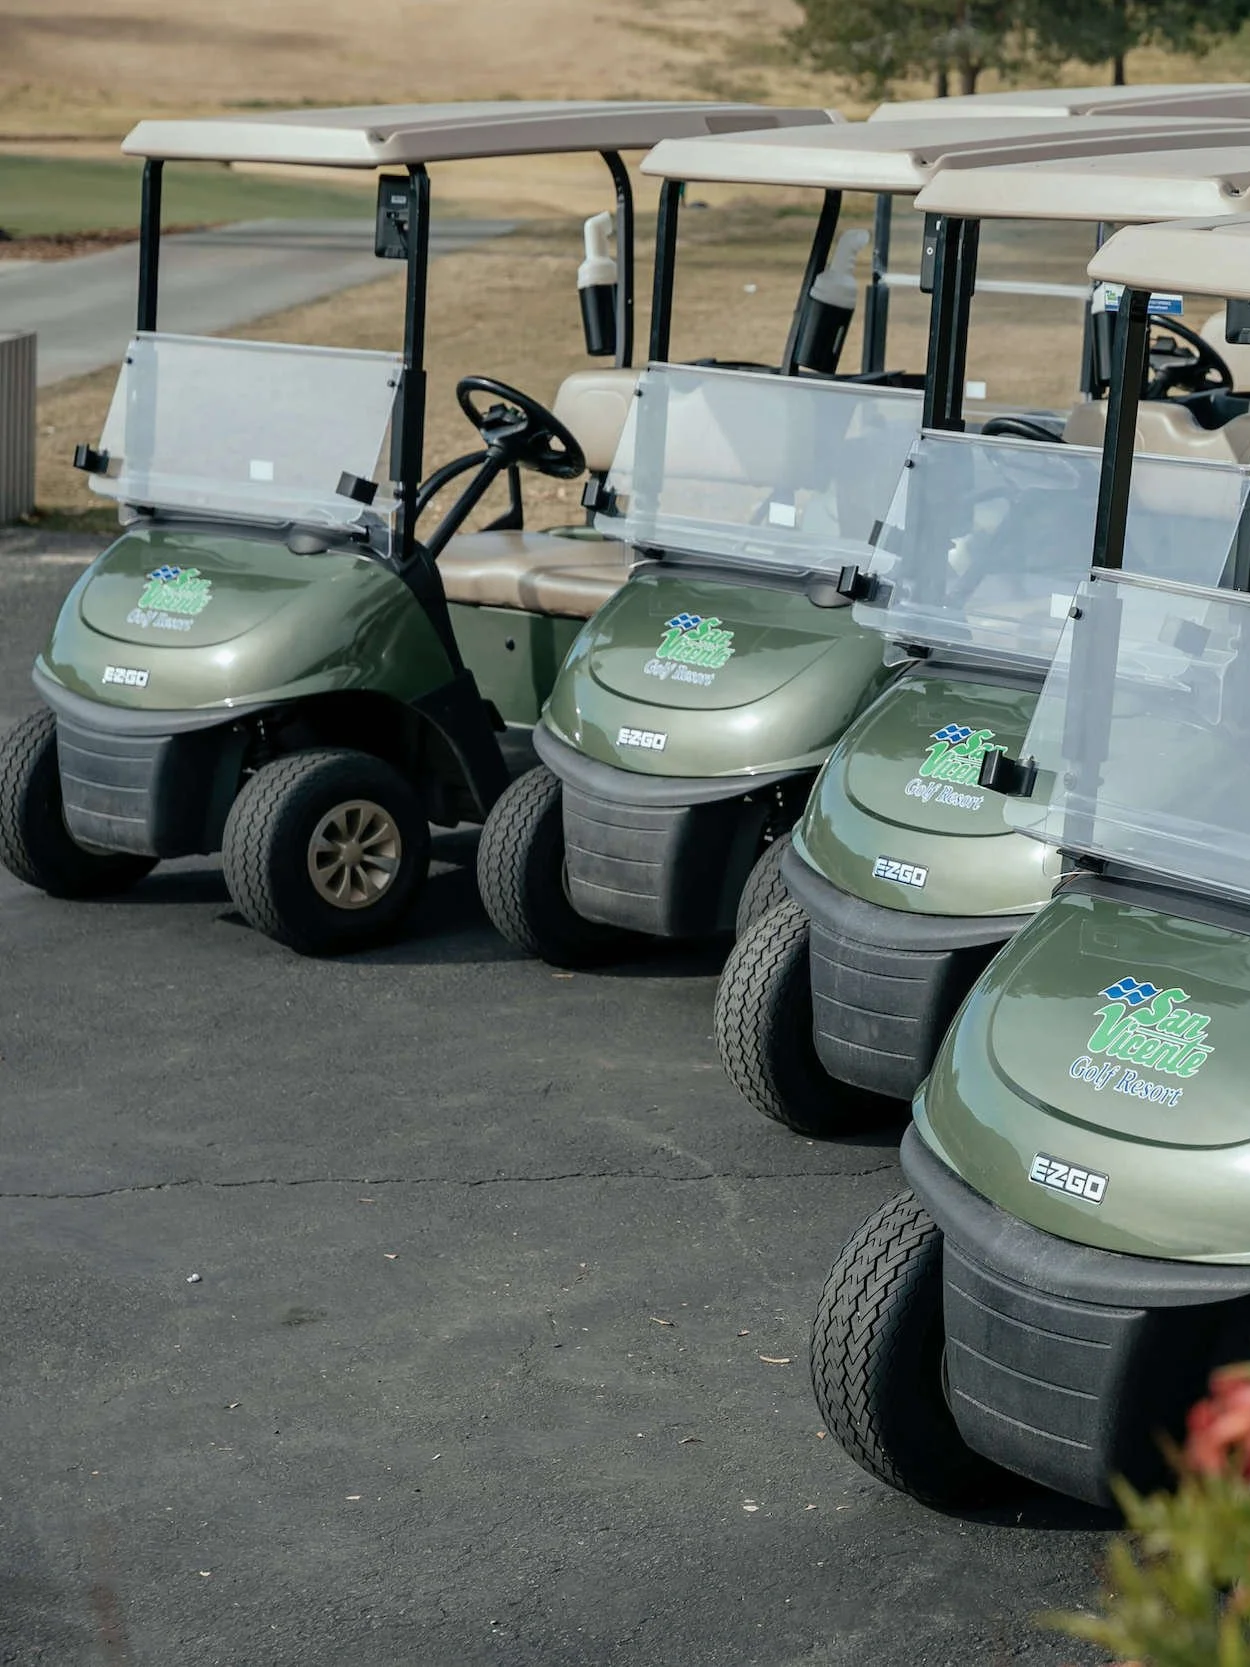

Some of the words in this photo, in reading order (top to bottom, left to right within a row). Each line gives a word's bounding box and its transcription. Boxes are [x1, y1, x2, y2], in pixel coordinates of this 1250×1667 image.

[656, 628, 736, 669] Vicente
[681, 617, 735, 646] San
[644, 659, 678, 680] Golf
[619, 727, 667, 750] EZGO
[919, 741, 983, 786] Vicen
[905, 777, 941, 803] Golf
[935, 785, 984, 811] Resort
[875, 858, 928, 887] EZGO
[1131, 988, 1212, 1038] San
[1087, 1003, 1215, 1078] Vicente
[1069, 1055, 1120, 1091] Golf
[1114, 1068, 1184, 1107] Resort
[1031, 1155, 1106, 1201] EZGO
